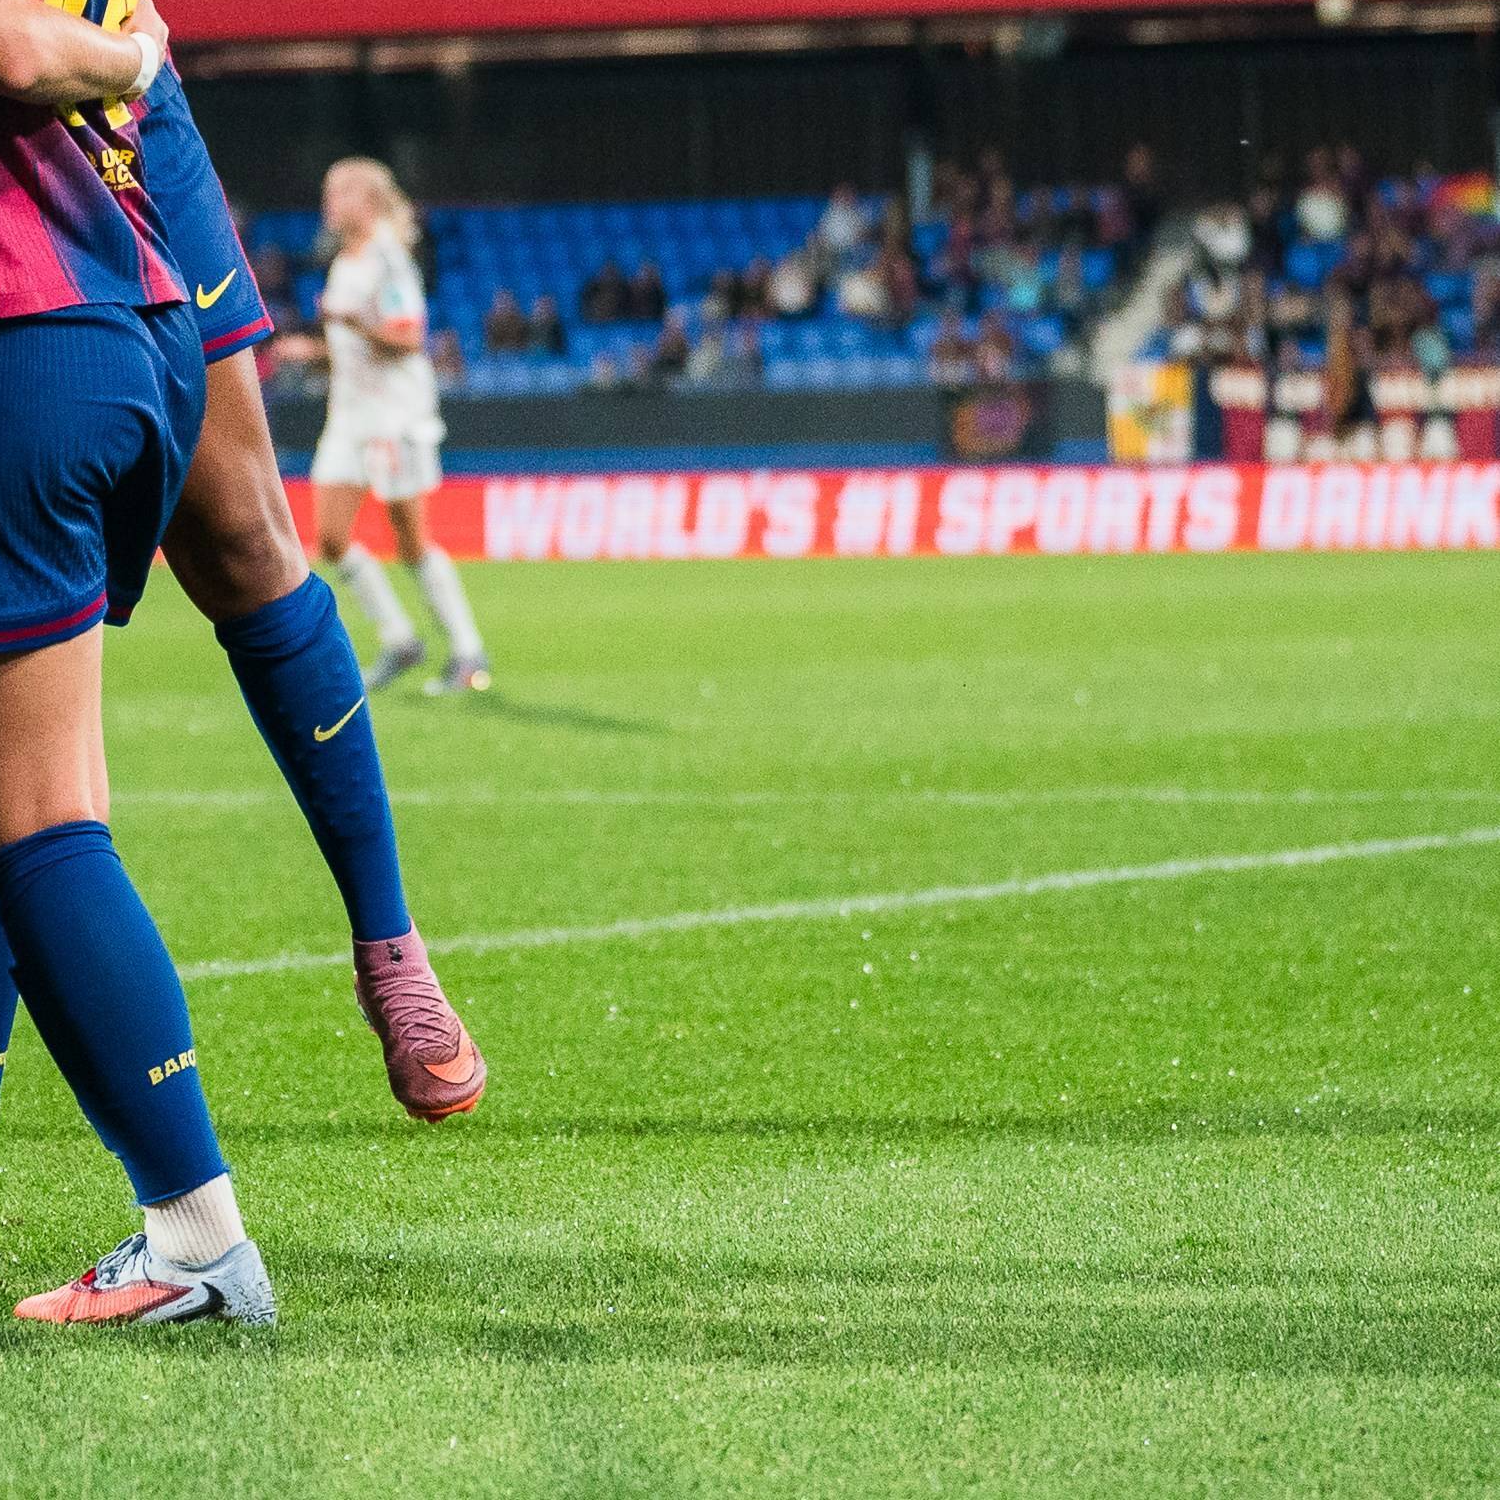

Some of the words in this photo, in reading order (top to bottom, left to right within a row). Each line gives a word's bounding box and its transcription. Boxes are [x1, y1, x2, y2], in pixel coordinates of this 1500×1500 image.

[484, 472, 818, 560] WORLD'S
[833, 472, 920, 557] #1
[934, 466, 1242, 554] SPORTS
[1257, 462, 1500, 550] DRINK
